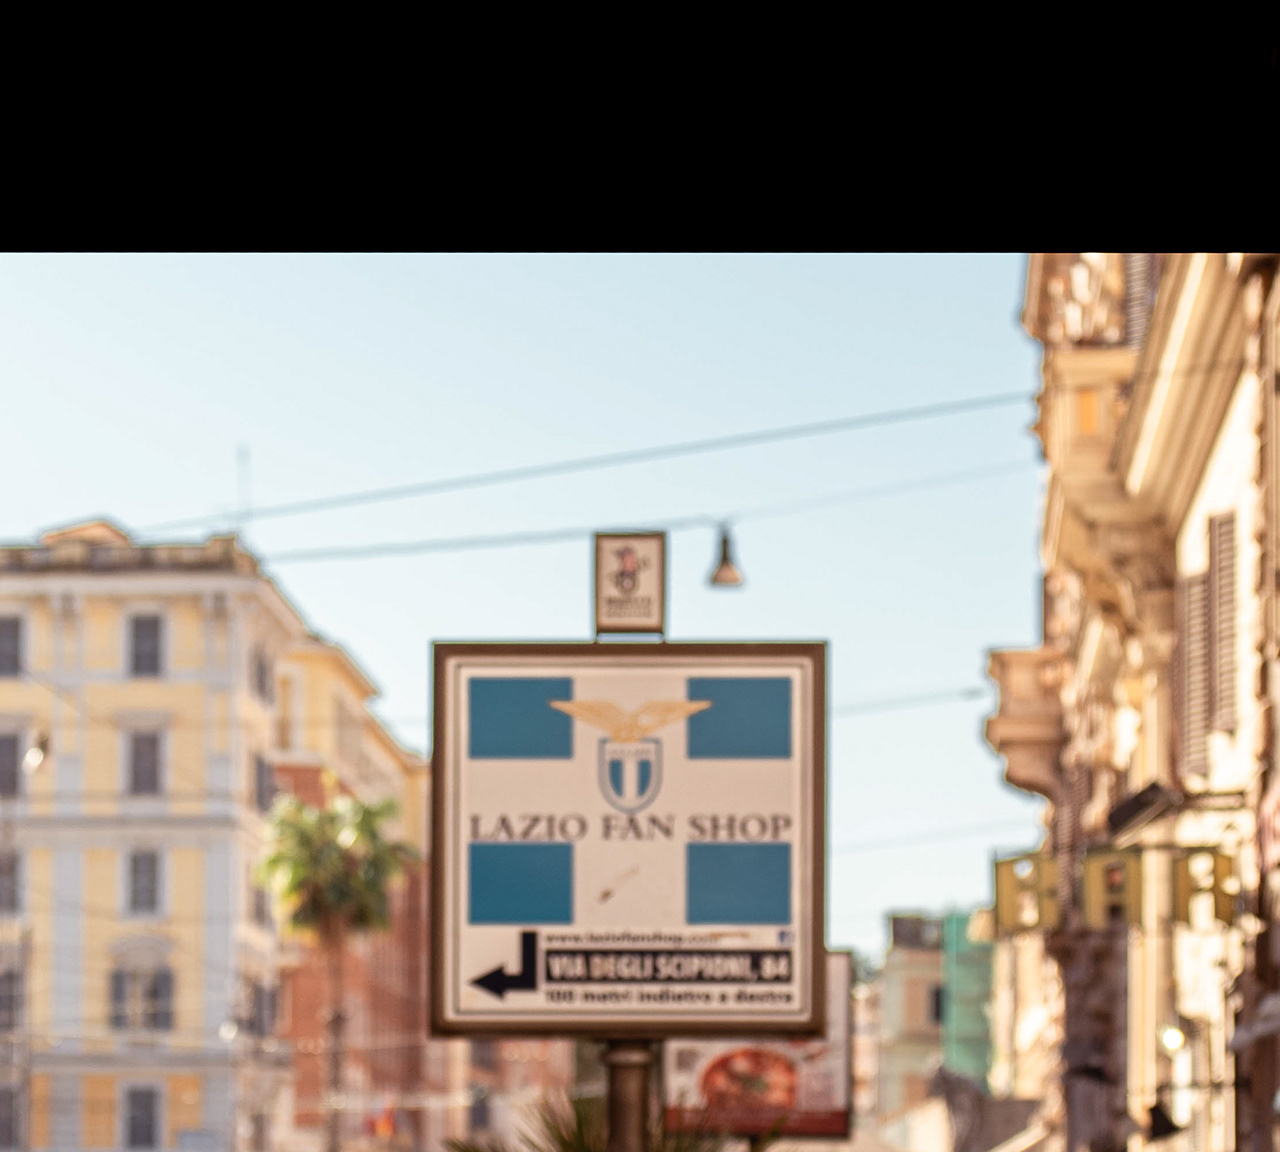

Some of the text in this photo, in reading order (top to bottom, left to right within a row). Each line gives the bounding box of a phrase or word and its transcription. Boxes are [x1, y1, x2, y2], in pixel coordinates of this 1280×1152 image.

[469, 813, 793, 841] LAZIO FAN SHOP
[548, 953, 586, 979] VIA
[588, 953, 654, 979] DEGLI
